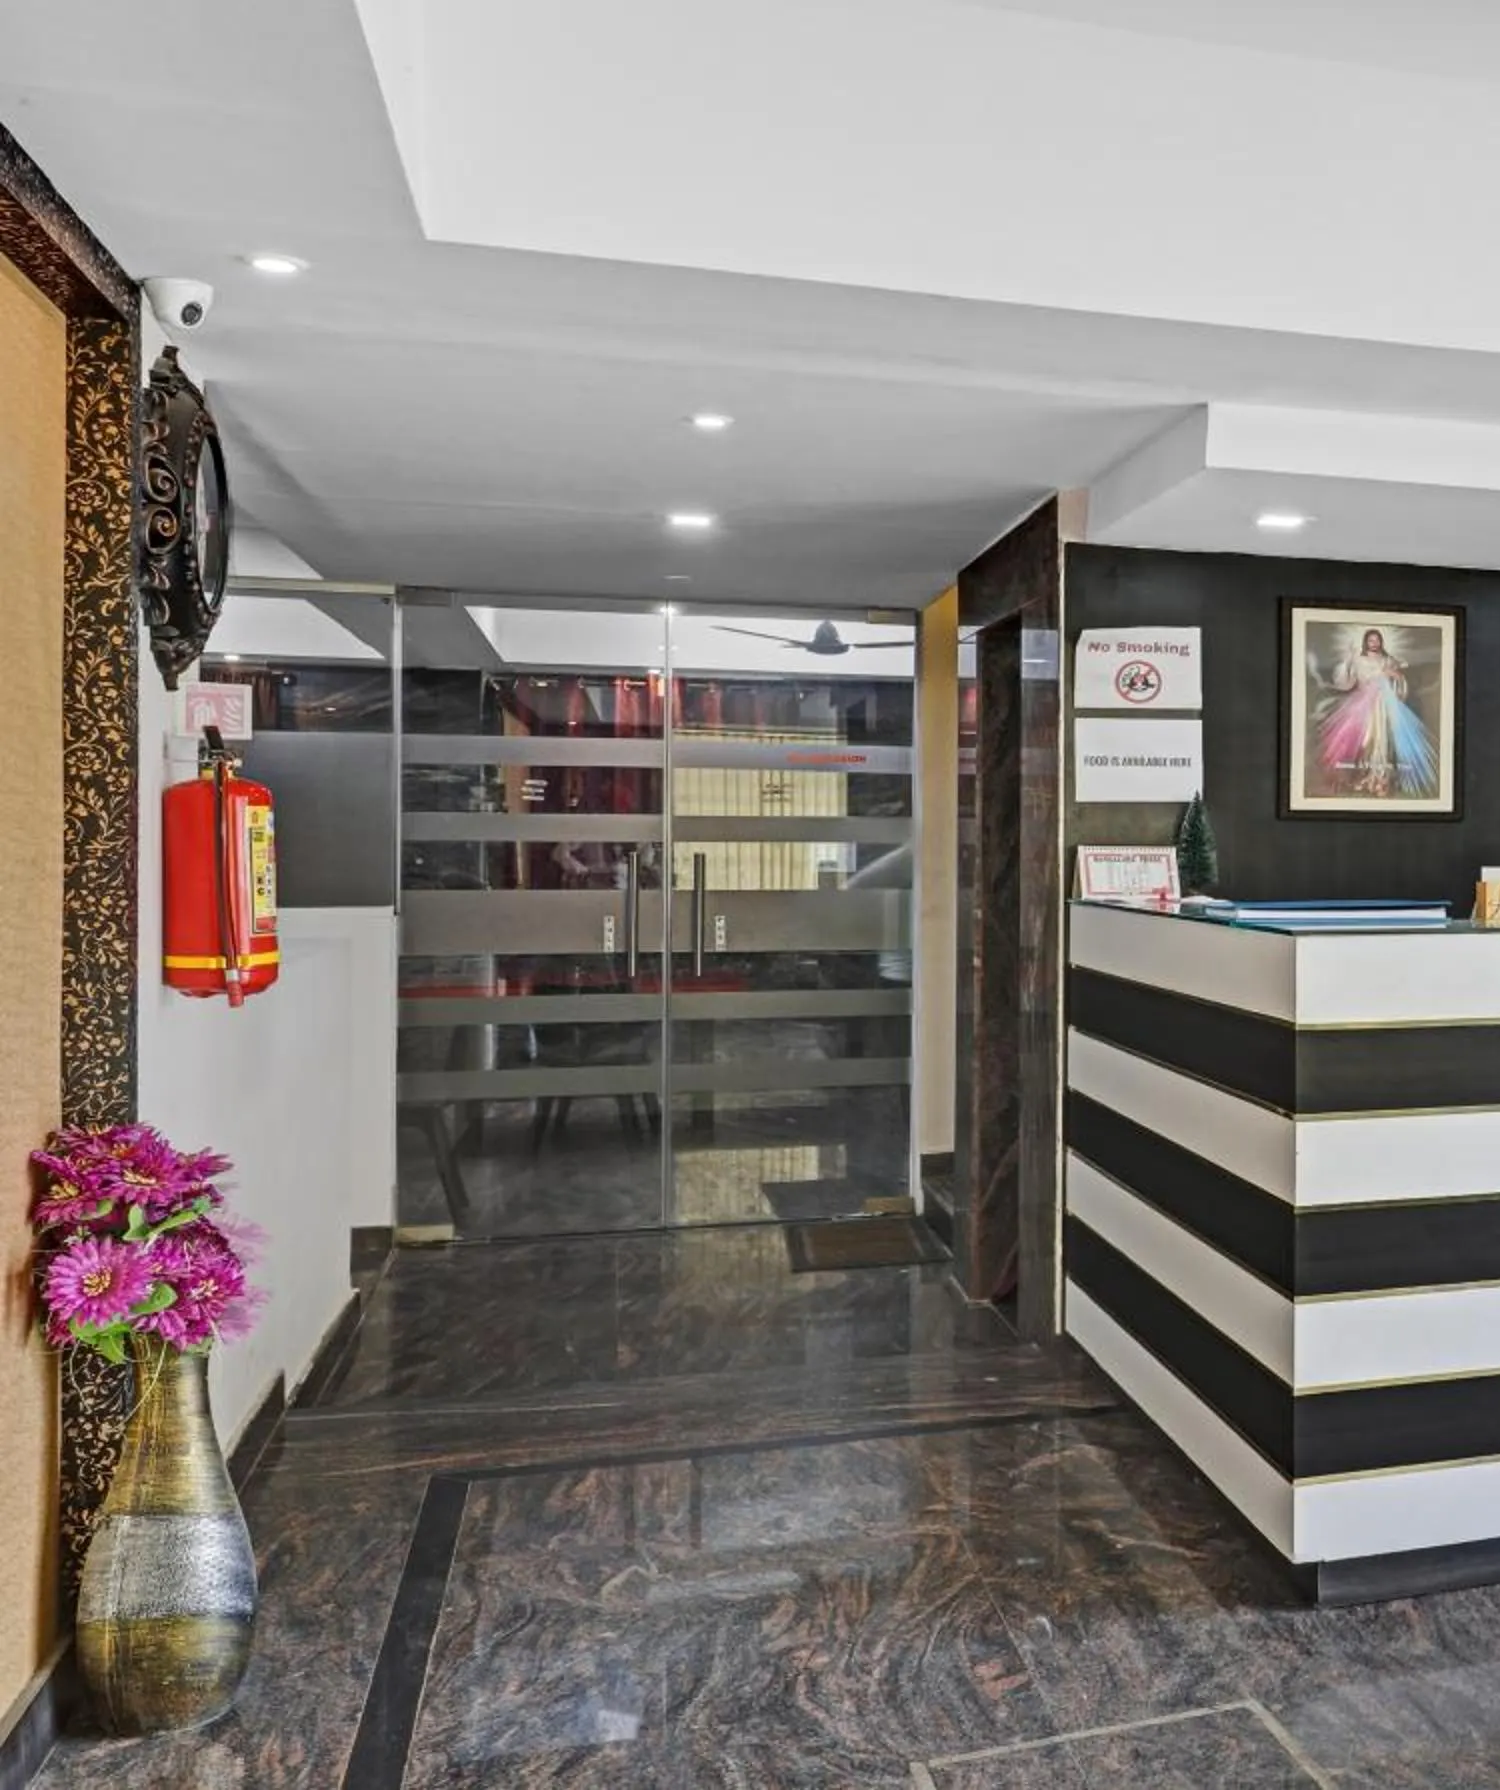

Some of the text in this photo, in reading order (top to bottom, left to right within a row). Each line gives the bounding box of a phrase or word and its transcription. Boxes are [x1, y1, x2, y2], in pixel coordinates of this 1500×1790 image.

[1087, 641, 1190, 656] No Smoking
[1083, 755, 1109, 767] FOOD
[1110, 755, 1121, 767] IS
[1121, 755, 1168, 768] AVAILABLE
